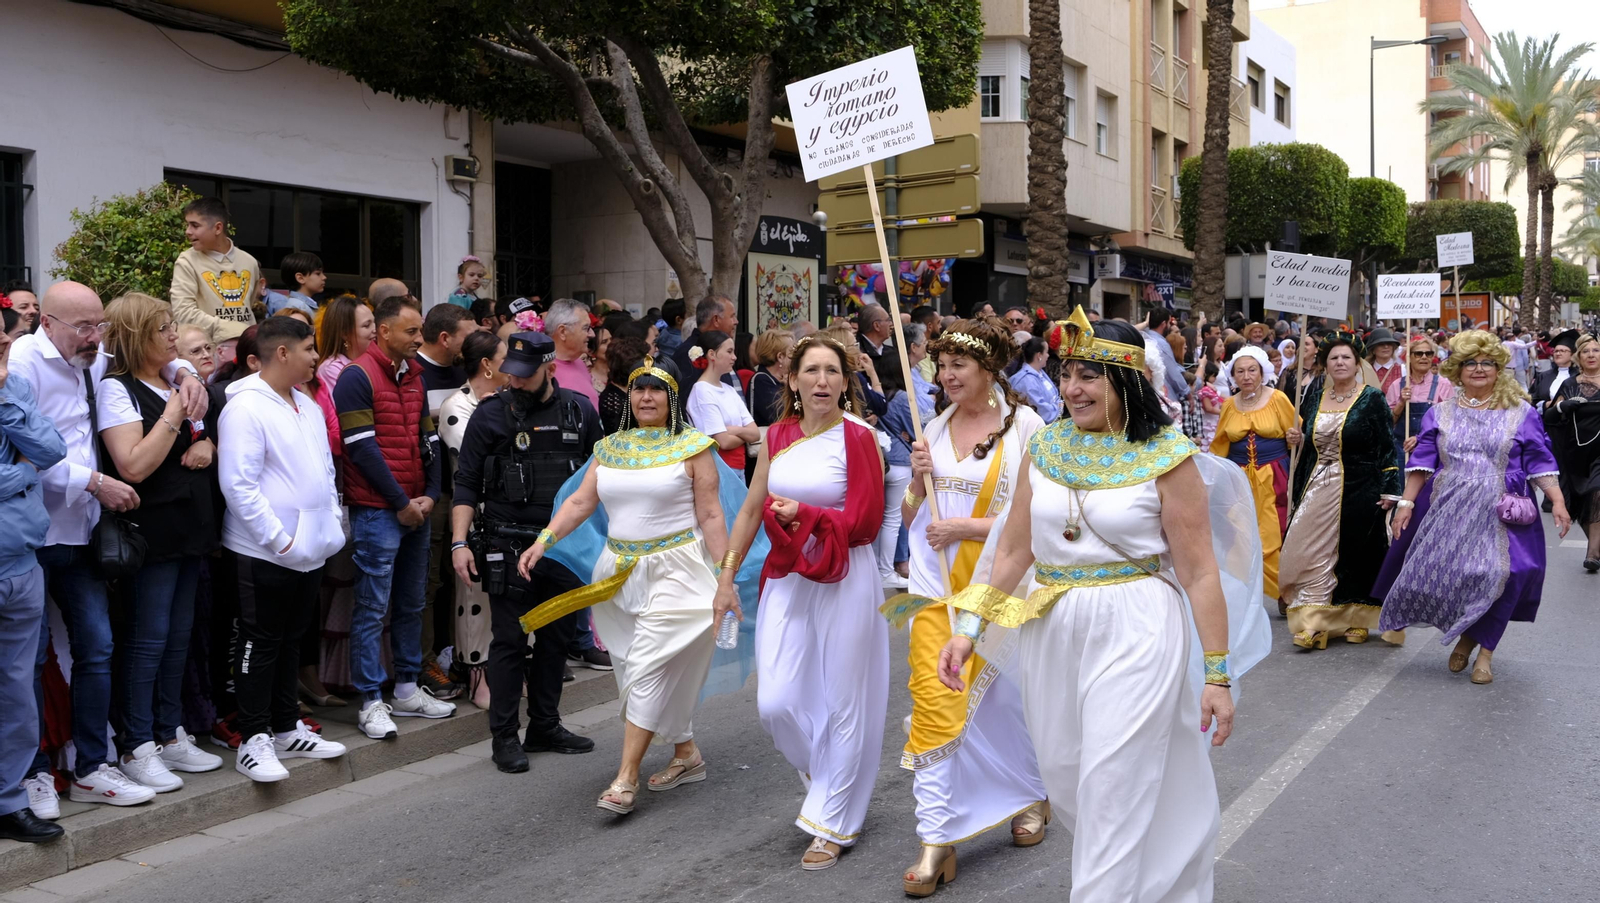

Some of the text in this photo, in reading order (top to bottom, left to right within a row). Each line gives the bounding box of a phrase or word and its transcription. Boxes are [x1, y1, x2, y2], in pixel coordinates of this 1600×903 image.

[804, 68, 888, 108] Imperio
[824, 87, 896, 119] romano
[805, 101, 899, 148] y egipcio
[808, 121, 914, 160] NO ERAMOS CONSIDERADAS
[818, 133, 916, 169] CIUDADANAS DE DERECHO
[1439, 236, 1456, 244] Edad
[1443, 243, 1470, 251] Moderna
[1271, 255, 1350, 276] Edad media
[1272, 274, 1340, 292] y barroco
[1380, 277, 1435, 287] Revolucion
[1383, 289, 1436, 299] industrial
[215, 308, 242, 316] HAVE
[1393, 302, 1430, 310] años 20
[241, 658, 250, 674] JUST
